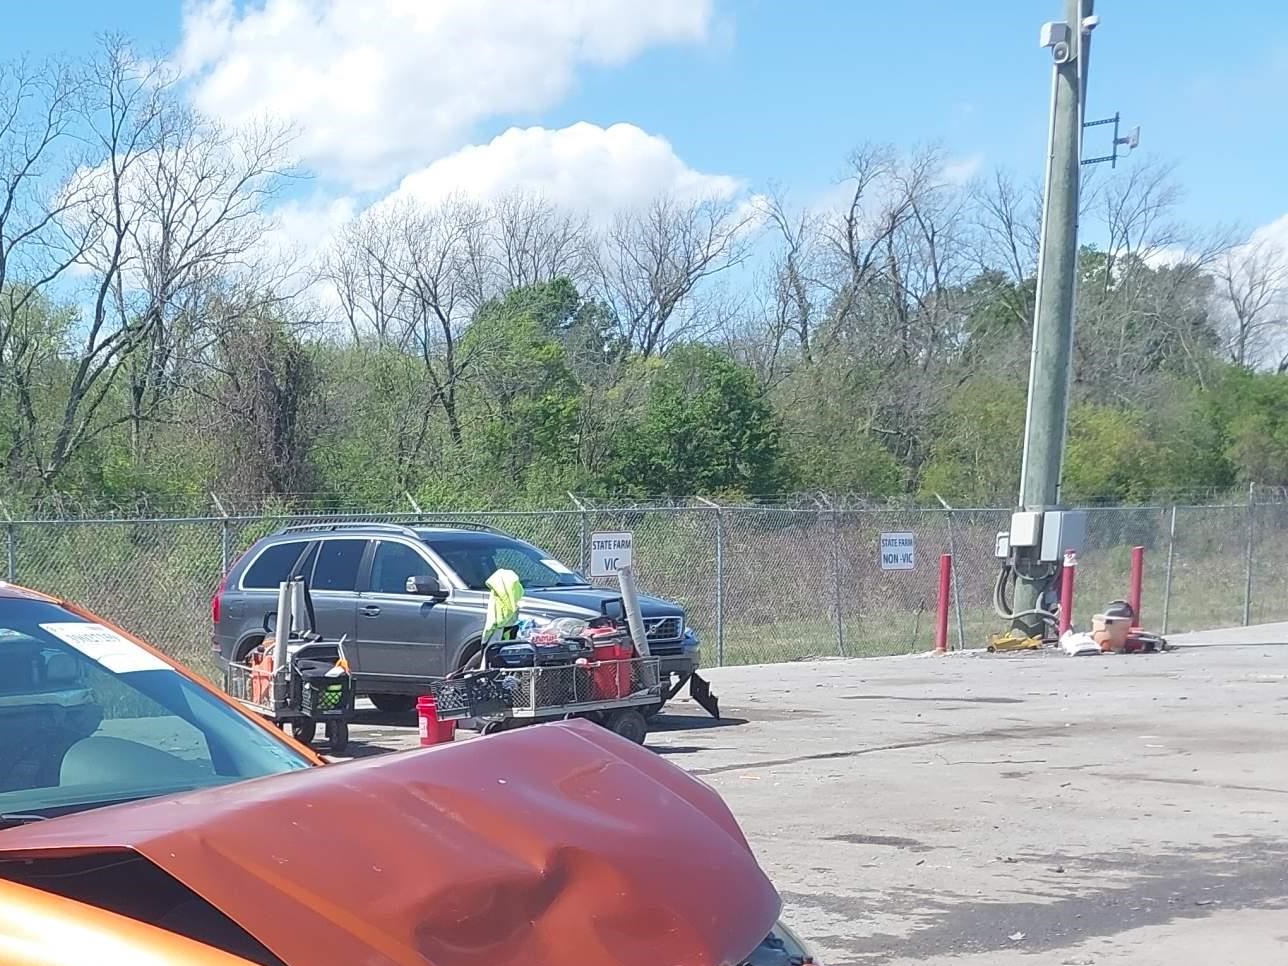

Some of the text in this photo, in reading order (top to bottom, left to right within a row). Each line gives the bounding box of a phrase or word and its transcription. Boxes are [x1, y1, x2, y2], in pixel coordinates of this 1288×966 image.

[592, 540, 631, 551] STATE FARM
[881, 538, 898, 548] STATE
[604, 557, 620, 571] VIC
[883, 553, 899, 565] NON
